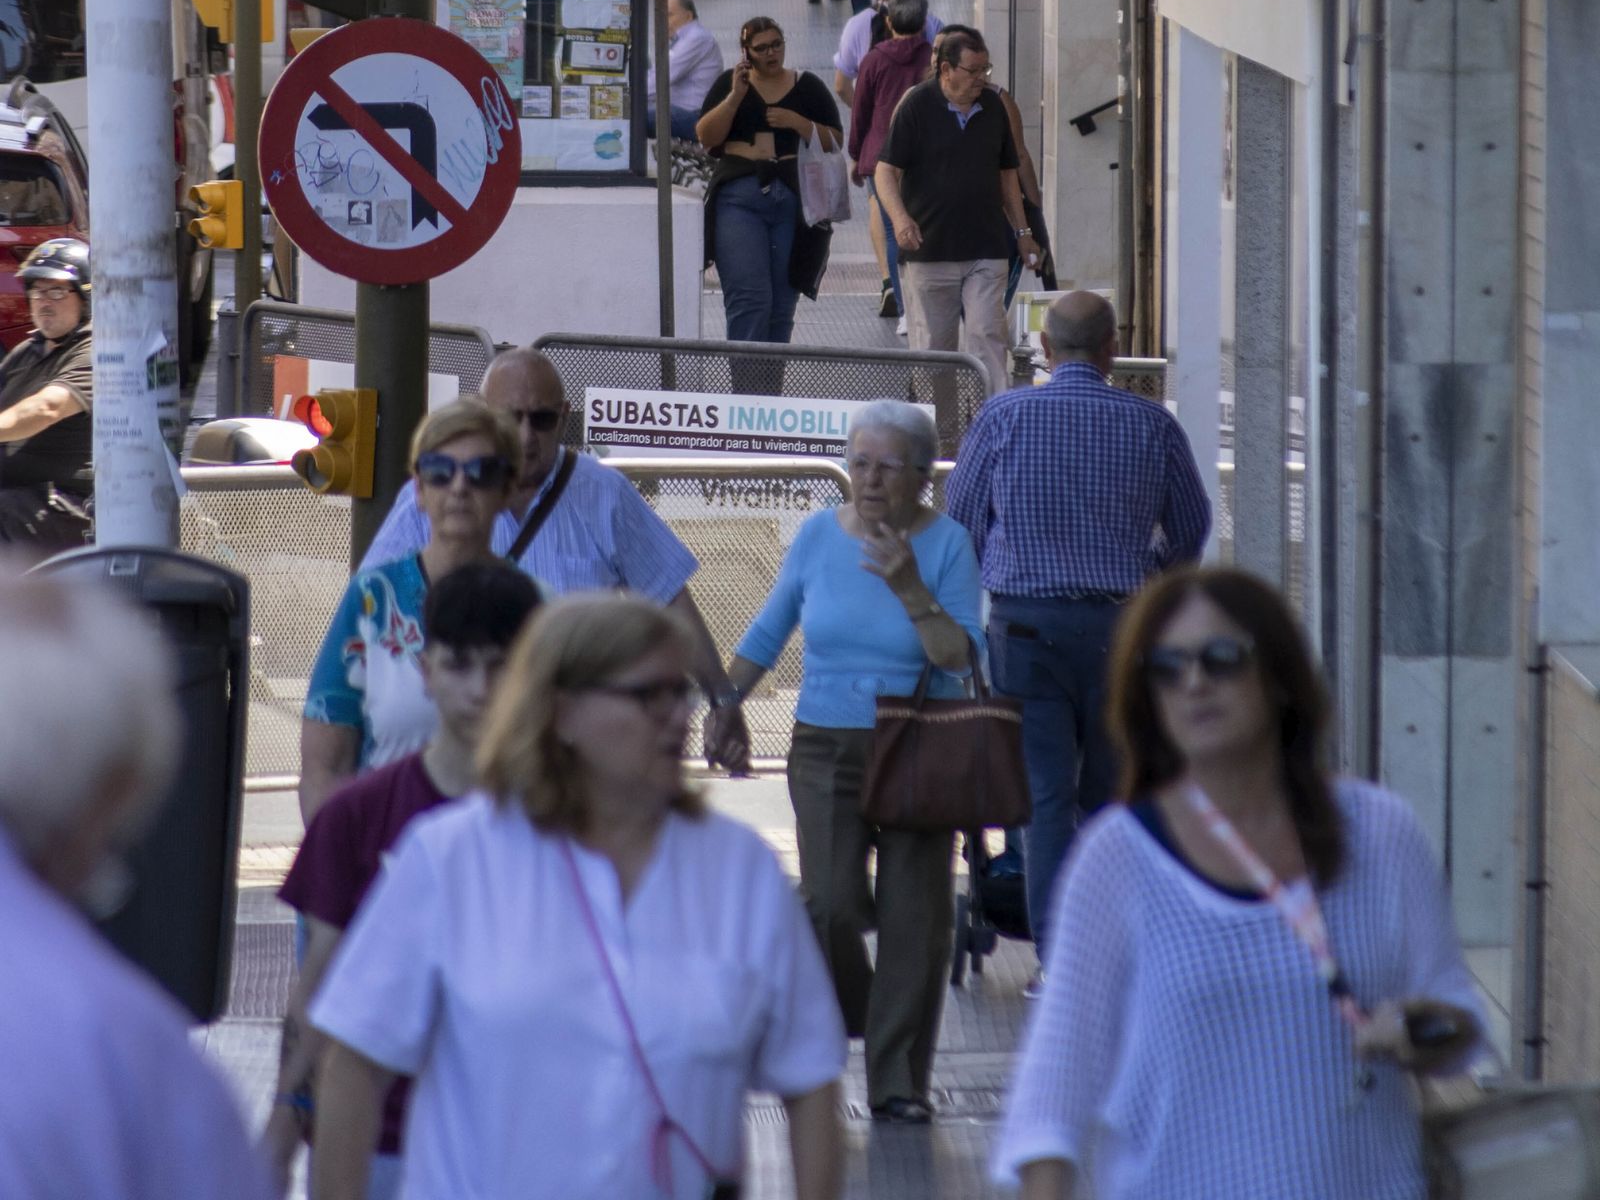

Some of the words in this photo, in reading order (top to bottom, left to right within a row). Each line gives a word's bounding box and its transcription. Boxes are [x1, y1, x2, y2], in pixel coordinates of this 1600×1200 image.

[590, 398, 720, 429] SUBASTAS
[728, 405, 848, 436] INMOBILI
[588, 428, 651, 445] Localizamos
[653, 433, 666, 446] un
[668, 433, 723, 451] comprador
[725, 438, 750, 452] para
[751, 438, 762, 451] tu
[764, 438, 808, 454] vivienda
[810, 442, 824, 454] en
